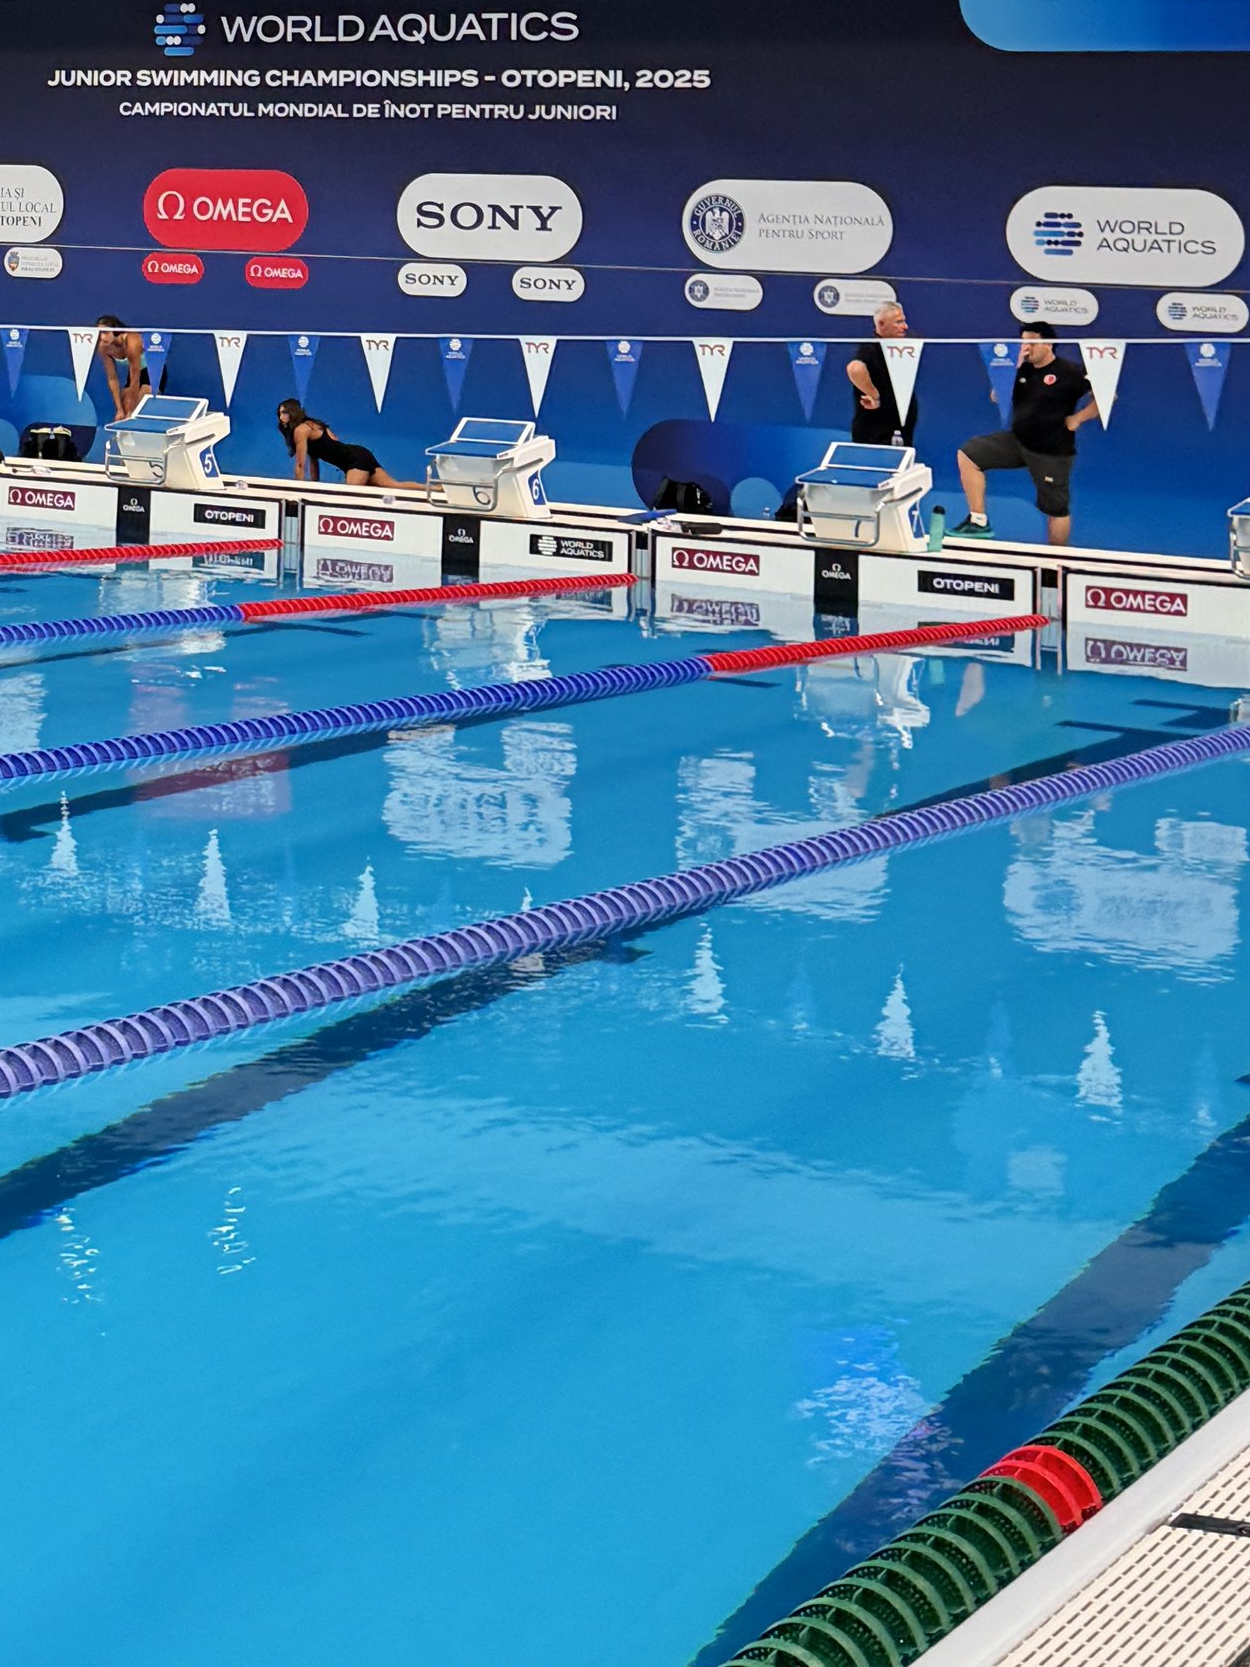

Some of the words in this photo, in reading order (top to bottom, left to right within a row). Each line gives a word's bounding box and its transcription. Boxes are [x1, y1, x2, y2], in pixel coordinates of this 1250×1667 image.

[220, 15, 365, 43] WORLD
[368, 11, 580, 45] AQUATICS
[48, 69, 132, 87] JUNIOR
[136, 69, 261, 87] SWIMMING
[265, 69, 479, 88] CHAMPIONSHIPS
[501, 69, 630, 91] OTOPENI,
[635, 69, 711, 89] 2025
[119, 102, 255, 117] CAMPIONATUL
[258, 102, 349, 118] MONDIAL
[352, 104, 381, 118] DE
[383, 100, 434, 119] ÎNOT
[437, 104, 524, 120] PENTRU
[528, 104, 617, 120] JUNIORI
[18, 201, 56, 214] LOCAL
[192, 196, 294, 224] OMEGA
[694, 196, 741, 219] GUVERNUL
[415, 201, 563, 232] SONY
[1096, 219, 1185, 235] WORLD
[1096, 237, 1217, 255] AQUATICS
[160, 262, 199, 274] OMEGA
[263, 267, 304, 279] OMEGA
[404, 272, 460, 286] SONY
[519, 277, 577, 291] SONY
[1043, 299, 1078, 307] WORLD
[72, 333, 93, 344] TYR
[219, 336, 241, 347] TYR
[365, 339, 389, 351] TYR
[525, 342, 550, 354] TYR
[699, 344, 726, 357] TYR
[886, 345, 915, 358] TYR
[1085, 346, 1118, 359] TYR
[204, 454, 213, 474] 5
[532, 478, 540, 500] 6
[24, 490, 75, 508] OMEGA
[204, 509, 255, 523] OTOPENI
[911, 510, 919, 533] 7
[336, 519, 393, 539] OMEGA
[448, 534, 474, 544] OMEGA
[560, 540, 594, 550] WORLD
[560, 547, 604, 559] AQUATICS
[693, 553, 759, 575] OMEGA
[821, 569, 851, 580] OMEGA
[932, 576, 1000, 595] OTOPENI
[1109, 591, 1187, 614] OMEGA
